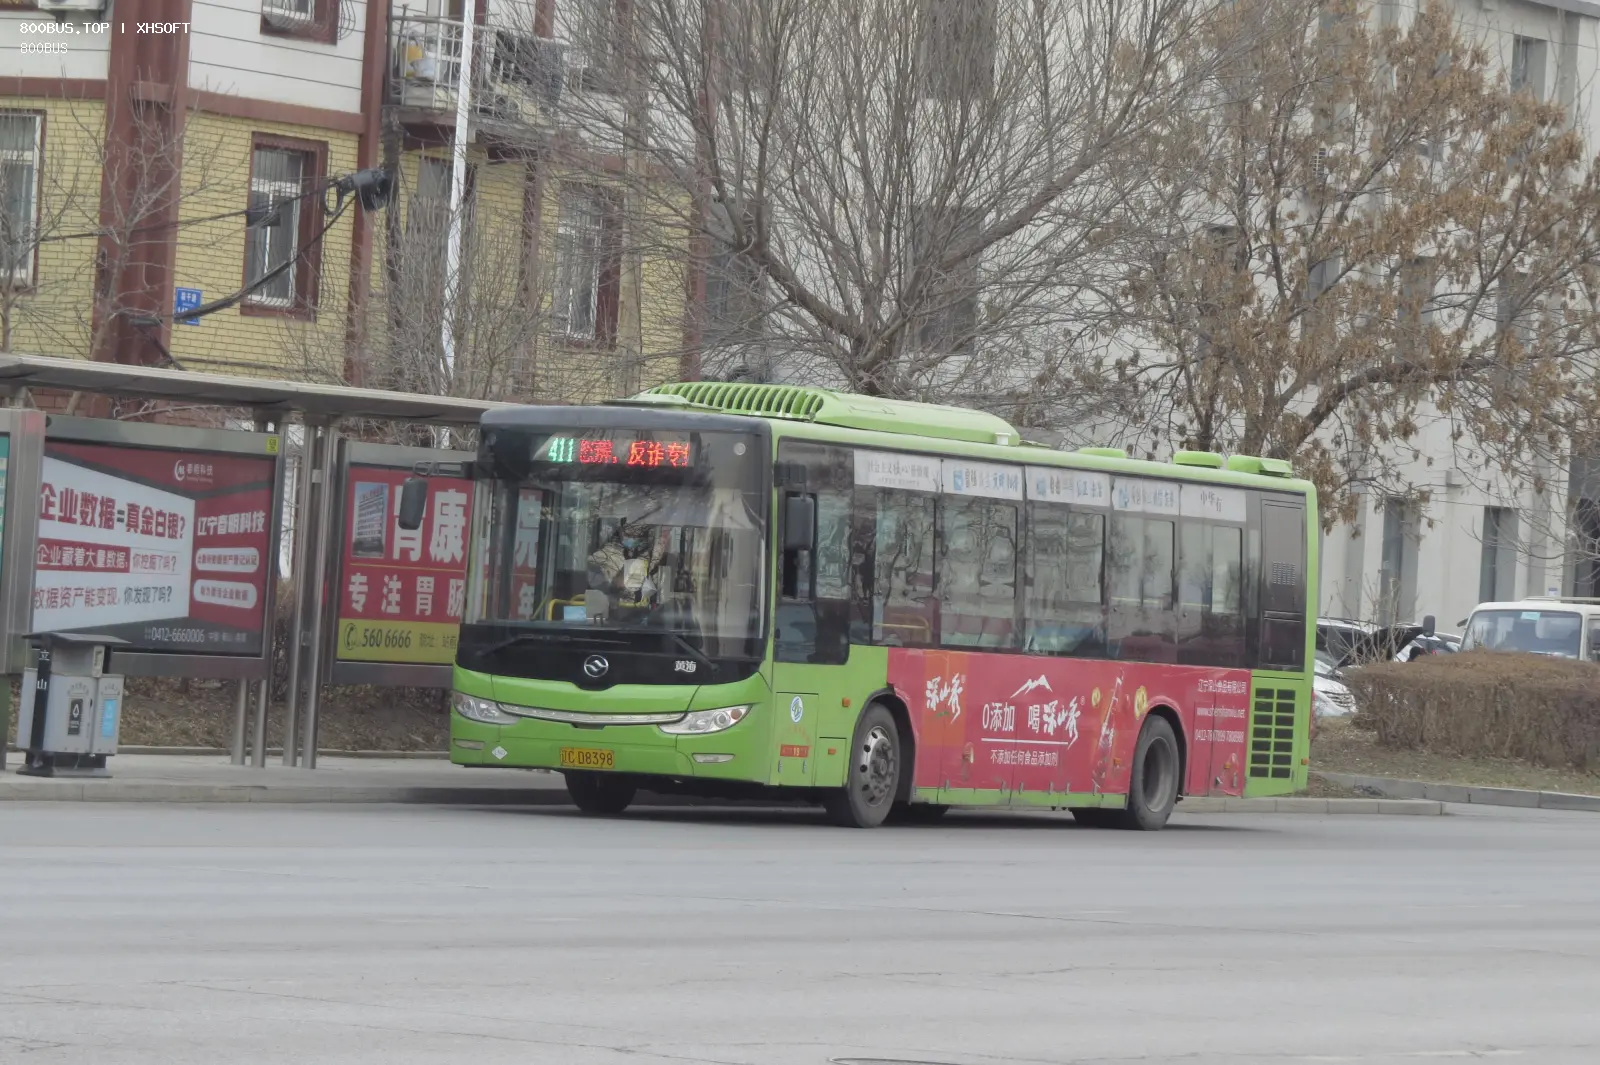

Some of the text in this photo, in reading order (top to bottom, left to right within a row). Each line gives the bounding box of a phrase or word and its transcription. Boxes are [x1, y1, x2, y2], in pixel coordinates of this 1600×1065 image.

[548, 437, 574, 463] 411
[362, 629, 382, 648] 560
[384, 630, 412, 649] 6666
[674, 660, 697, 673] 黄海
[990, 749, 1058, 766] 不添加任何食品添加剂
